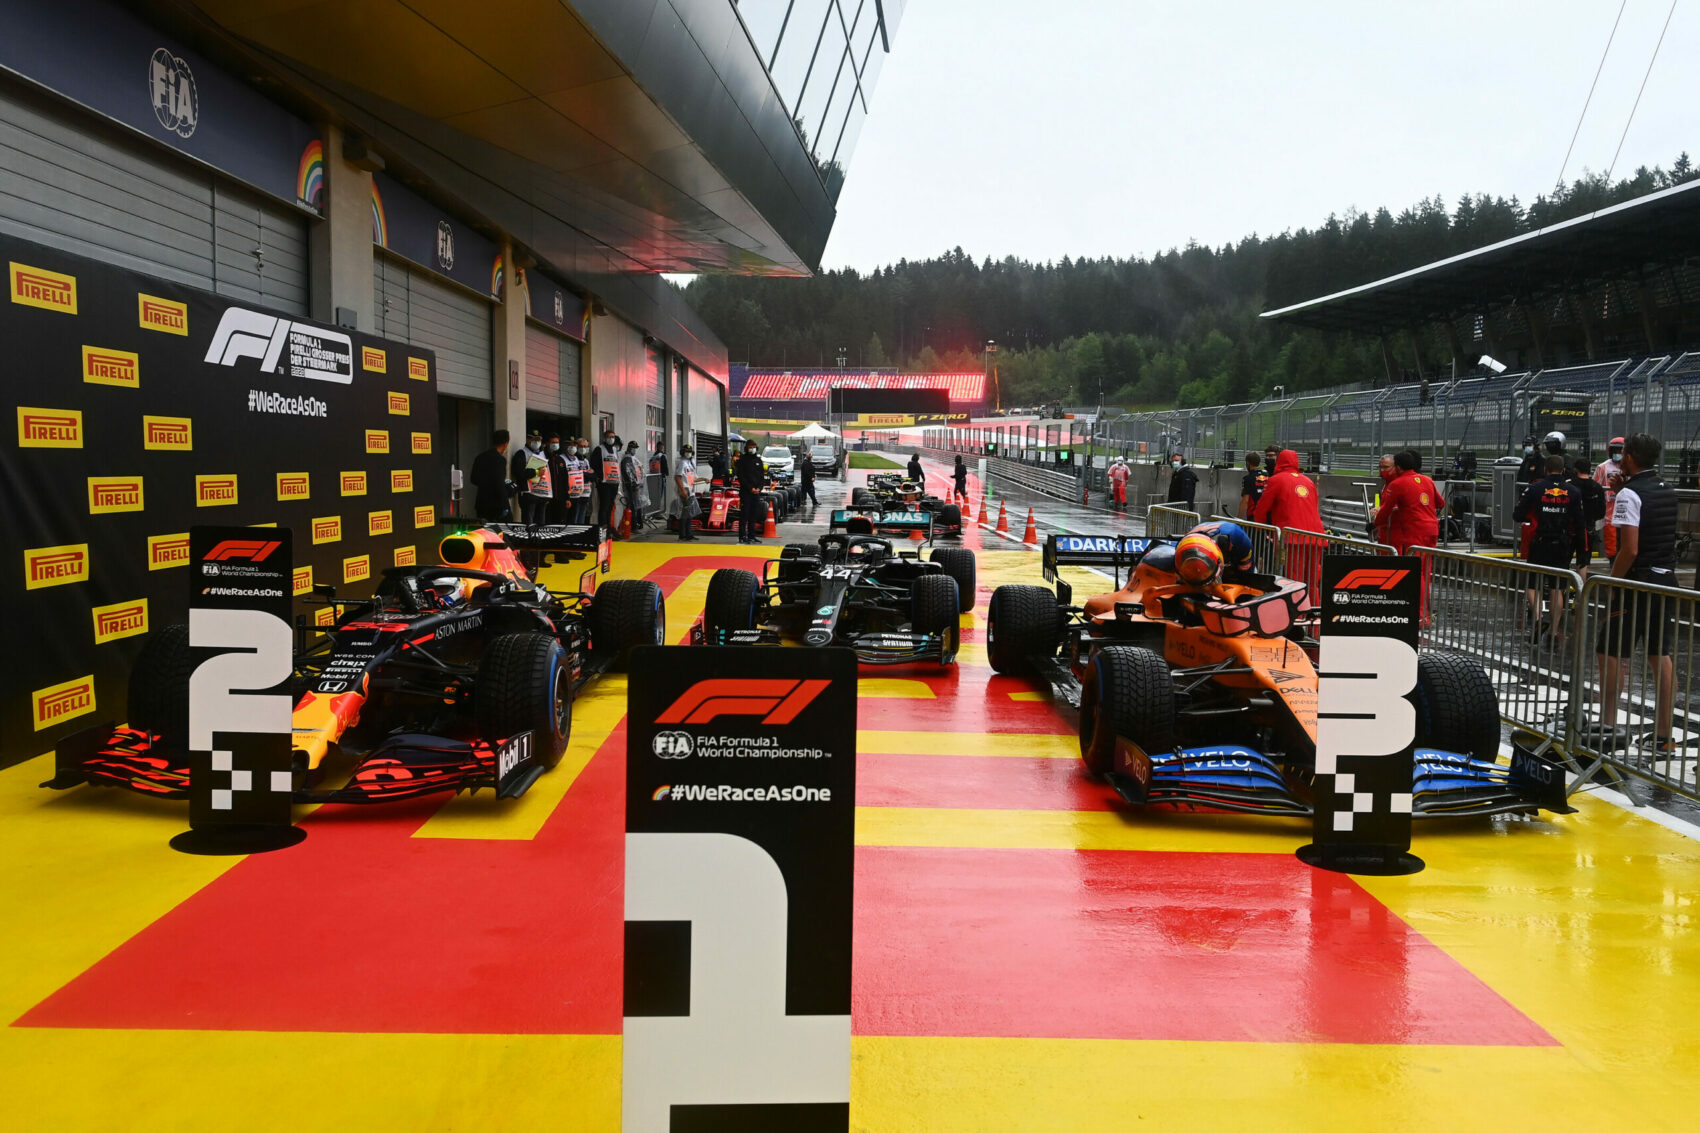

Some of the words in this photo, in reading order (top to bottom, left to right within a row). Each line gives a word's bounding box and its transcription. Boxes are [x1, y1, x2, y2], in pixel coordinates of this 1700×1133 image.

[16, 271, 72, 305] PIRELLI
[144, 301, 184, 329] PIRELLI
[312, 348, 335, 361] GROSSER
[365, 351, 385, 369] PIRELLI
[88, 353, 135, 380] PIRELLI
[411, 361, 427, 377] PIRELLI
[248, 389, 327, 417] #WeRaceAsOne
[391, 396, 409, 411] PIRELLI
[24, 415, 78, 441] PIRELLI
[869, 414, 904, 424] PIRELLI
[148, 423, 188, 444] PIRELLI
[368, 434, 387, 449] PIRELLI
[414, 436, 429, 450] PIRELLI
[200, 480, 235, 500] PIRELLI
[280, 477, 307, 495] PIRELLI
[343, 475, 364, 491] PIRELLI
[394, 474, 411, 489] PIRELLI
[94, 483, 139, 507] PIRELLI
[371, 514, 390, 531] PIRELLI
[417, 509, 432, 524] PIRELLI
[314, 521, 338, 539] PIRELLI
[152, 539, 190, 563] PIRELL
[31, 551, 84, 581] PIRELLI
[346, 559, 368, 578] PIRELLI
[820, 569, 851, 580] 44
[211, 587, 283, 597] #WeRaceAsOne
[98, 606, 143, 636] PIRELLI
[434, 622, 456, 641] ASTON
[457, 614, 483, 632] MARTIN
[1340, 615, 1409, 624] #WeRaceAsOne
[39, 683, 90, 722] PIRELLI
[697, 736, 718, 746] FIA
[720, 736, 770, 747] Formula
[771, 737, 779, 747] 1
[500, 738, 519, 781] Mobil
[697, 747, 734, 758] World
[736, 747, 823, 759] Championship
[1190, 750, 1251, 769] VELO
[1131, 756, 1148, 785] VELO
[1523, 758, 1552, 785] VELO
[671, 784, 831, 802] #WeRaceAsOne
